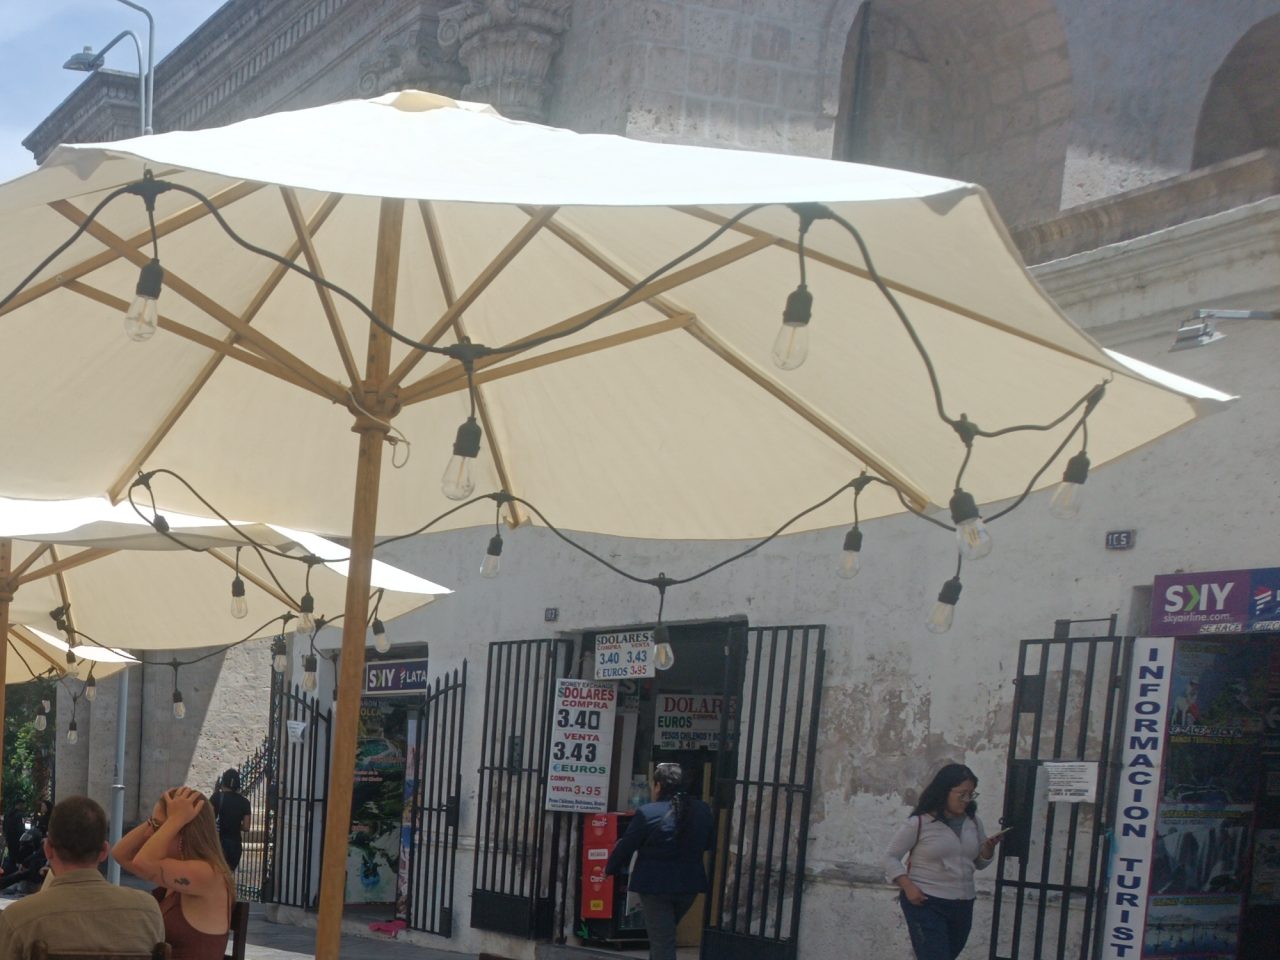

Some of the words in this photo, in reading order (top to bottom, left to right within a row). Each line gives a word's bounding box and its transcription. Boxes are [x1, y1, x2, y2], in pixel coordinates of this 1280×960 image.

[1164, 582, 1235, 612] SKY
[600, 652, 619, 665] 3.40
[627, 650, 647, 664] 3.43
[369, 668, 395, 688] SKY
[602, 667, 628, 678] EUROS
[630, 665, 647, 675] 3.95
[562, 700, 608, 709] COMPRA
[557, 709, 601, 730] 3.40
[658, 716, 692, 728] EUROS
[564, 733, 600, 741] VENTA
[1122, 647, 1165, 838] INFORMACION
[553, 741, 597, 762] 3.43
[552, 785, 573, 793] VENTA
[574, 785, 601, 796] 3.95
